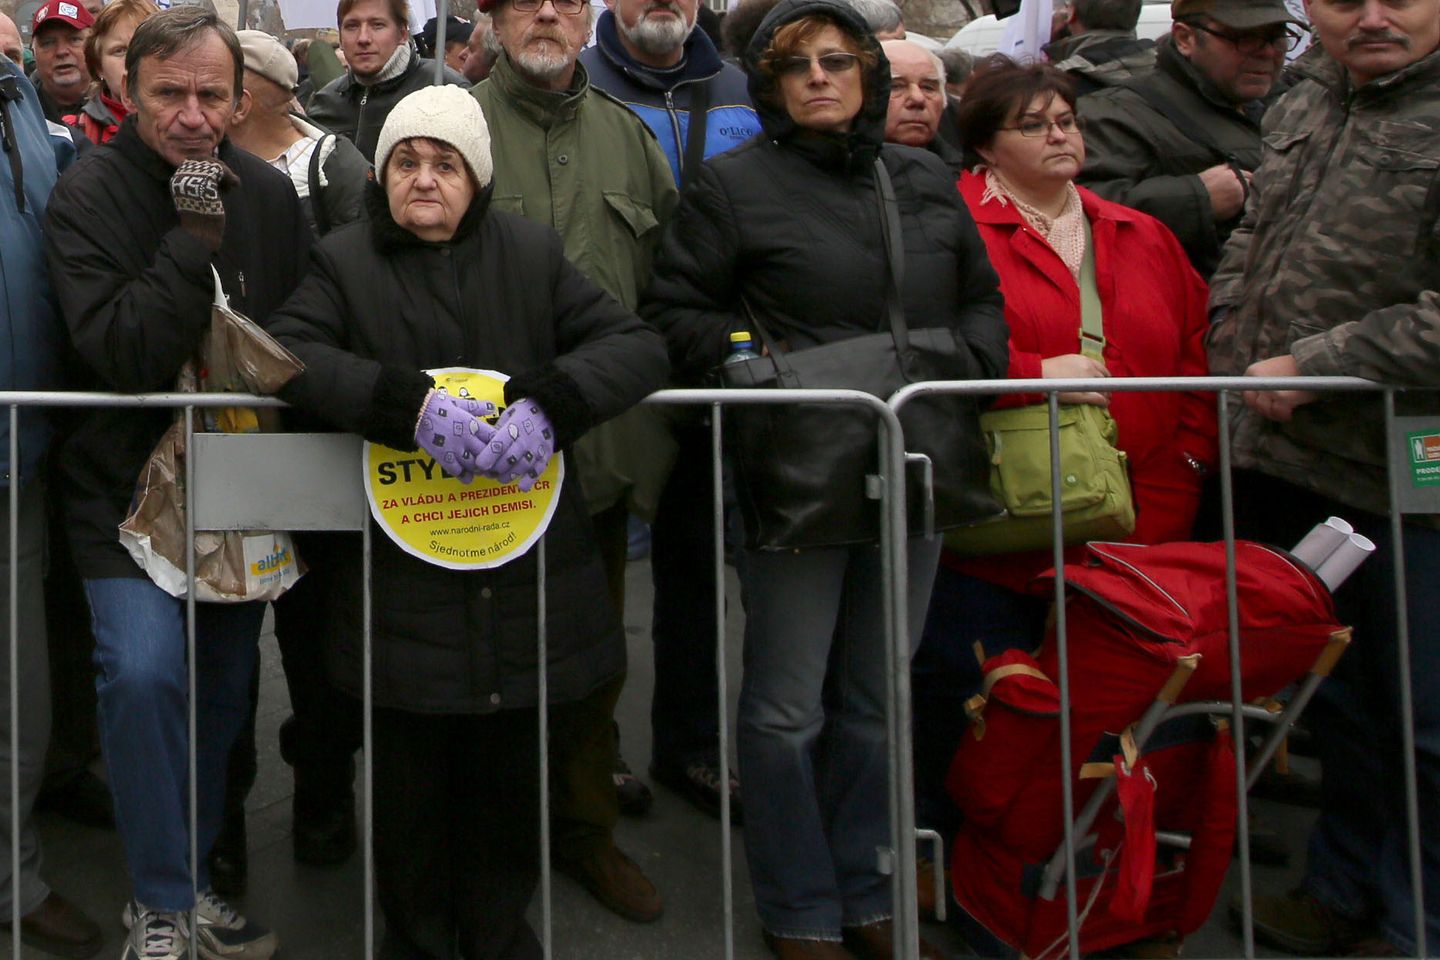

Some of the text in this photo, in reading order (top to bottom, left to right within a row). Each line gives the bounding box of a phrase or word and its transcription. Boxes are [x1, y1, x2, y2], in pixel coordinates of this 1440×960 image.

[383, 498, 398, 510] ZA
[402, 493, 443, 507] VLÁDU
[447, 493, 457, 503] A
[534, 480, 550, 491] ČR
[401, 499, 537, 525] A CHCI JEJICH DEMISI.
[430, 520, 511, 537] www.narodni-rada.cz
[429, 531, 517, 558] Sjednoťme národ!
